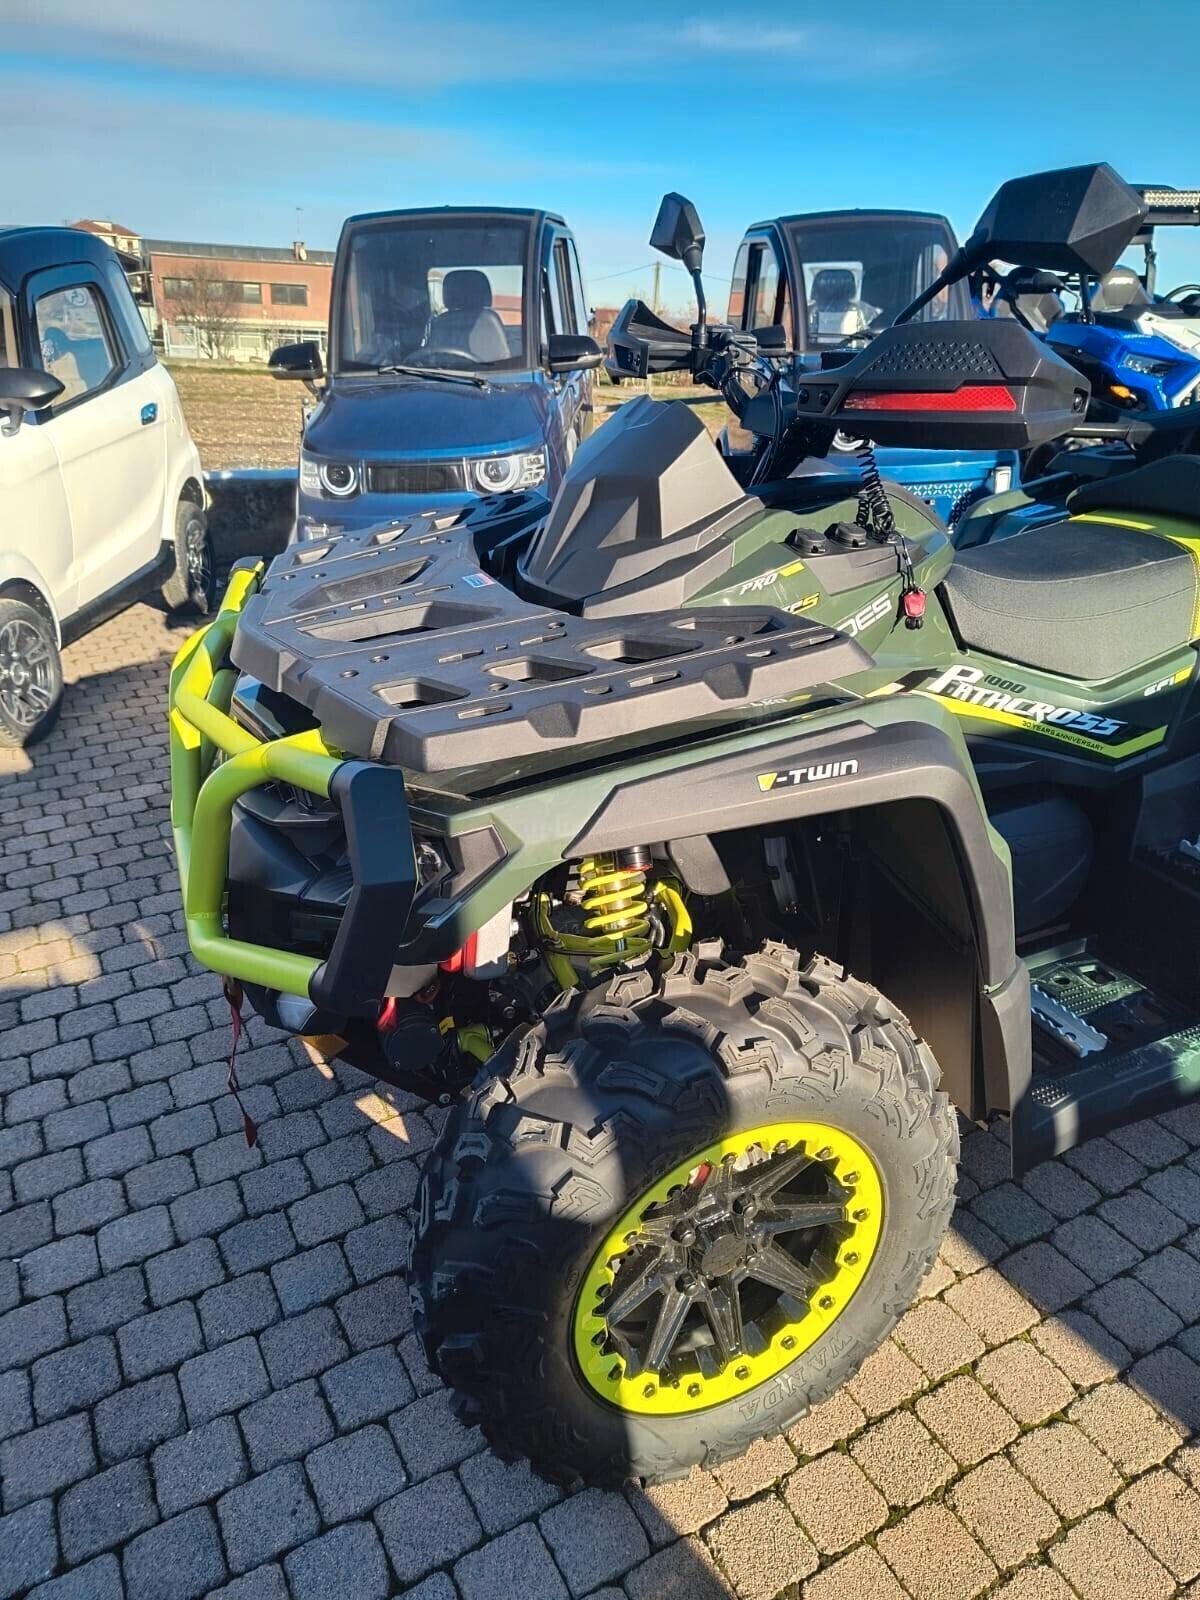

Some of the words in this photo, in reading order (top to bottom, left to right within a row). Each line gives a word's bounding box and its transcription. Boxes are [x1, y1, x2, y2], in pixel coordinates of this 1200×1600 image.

[740, 572, 778, 595] PRO
[781, 592, 820, 615] PS
[983, 674, 1028, 694] 1000
[926, 665, 1129, 736] PATHCROSS
[1032, 724, 1056, 736] YEARS
[1054, 731, 1105, 752] ANNIVERSARY
